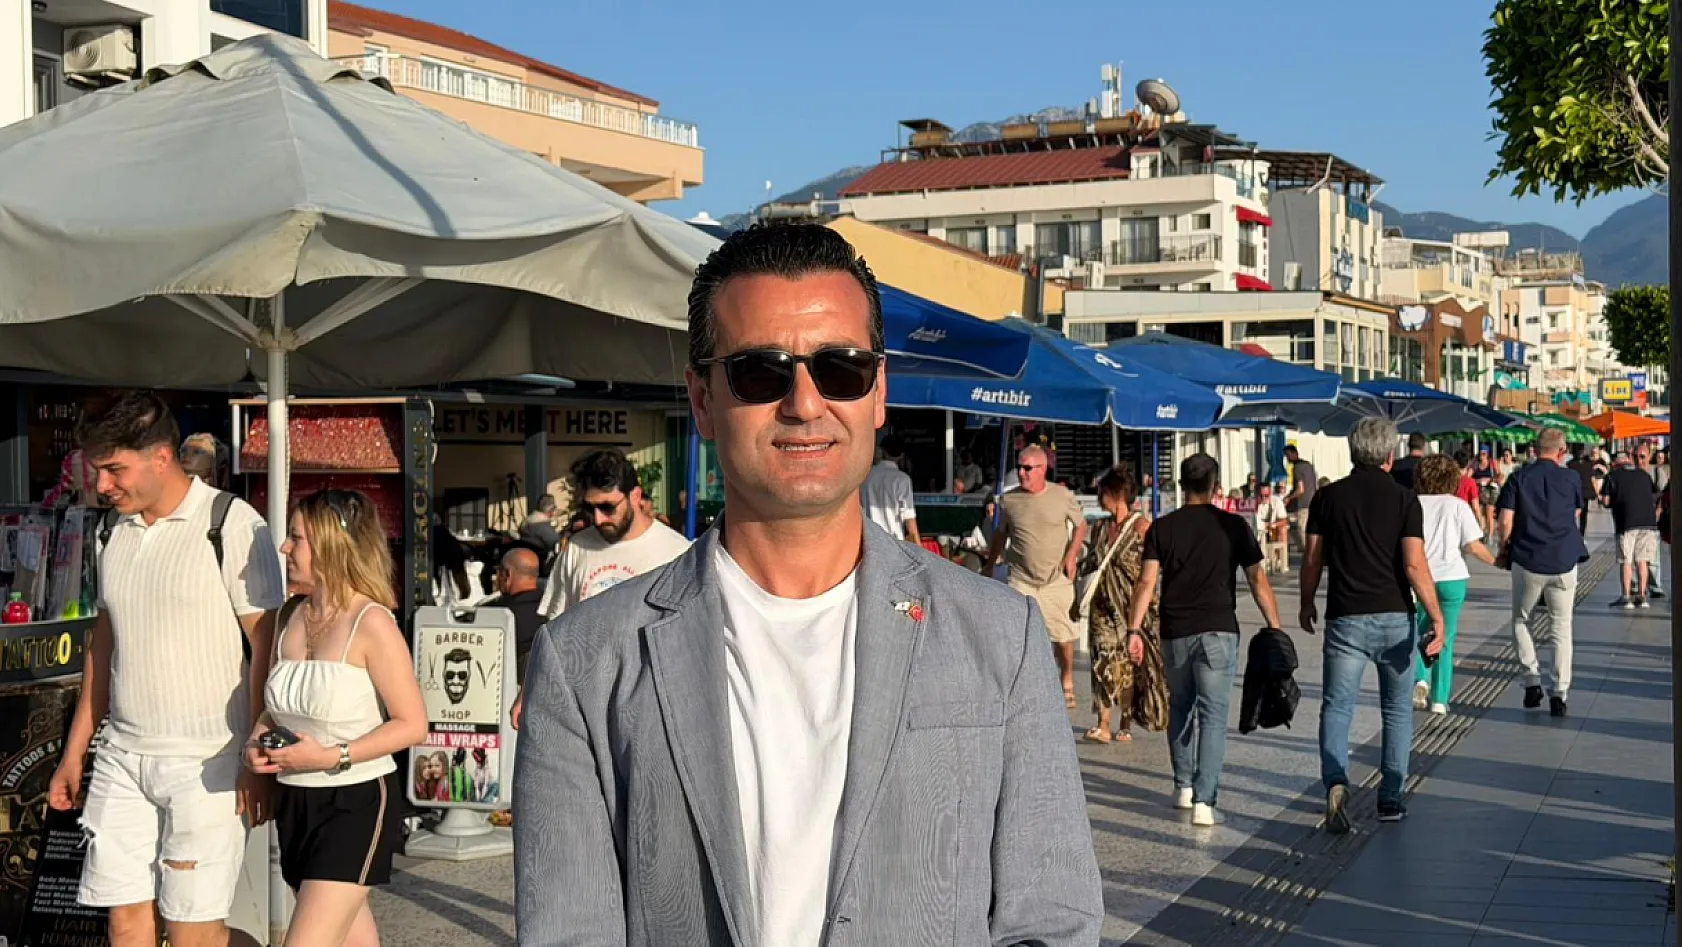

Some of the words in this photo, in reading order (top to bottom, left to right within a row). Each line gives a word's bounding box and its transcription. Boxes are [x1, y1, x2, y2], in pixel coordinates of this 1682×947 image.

[496, 409, 560, 434] MET
[566, 409, 628, 435] HERE
[435, 632, 484, 646] BARBER
[441, 709, 471, 720] SHOP
[435, 724, 476, 732] MASSAGE
[426, 734, 447, 747] AIR
[450, 734, 496, 747] WRAPS
[2, 746, 45, 788] TATTOOS
